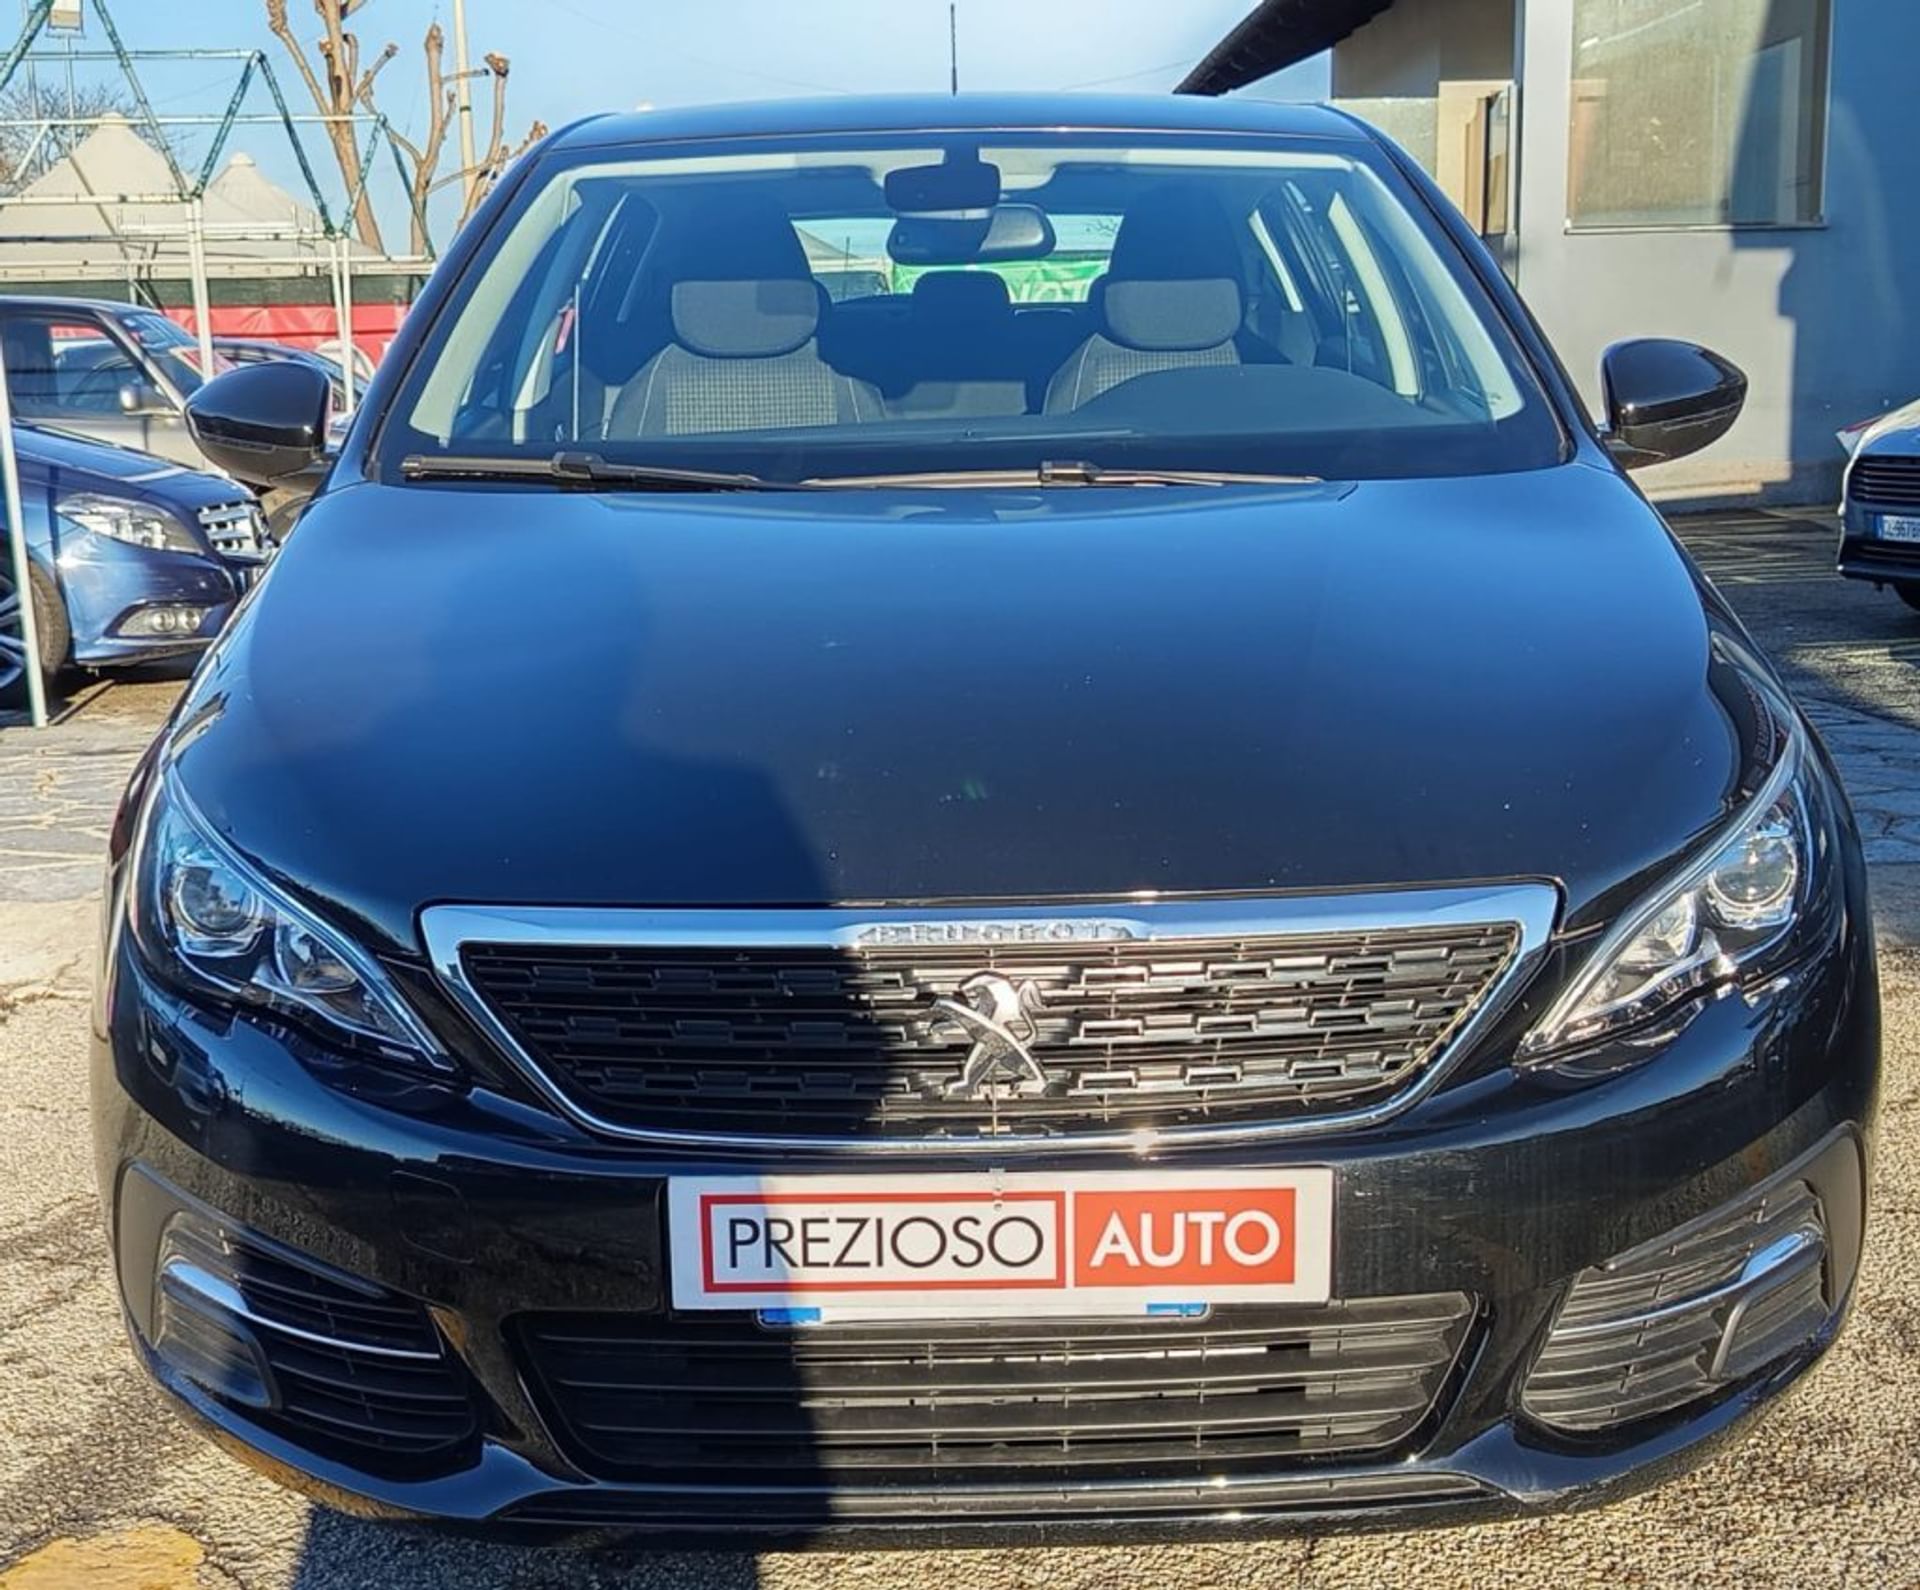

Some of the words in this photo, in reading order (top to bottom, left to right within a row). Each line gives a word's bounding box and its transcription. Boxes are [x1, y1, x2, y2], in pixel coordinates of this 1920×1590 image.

[873, 920, 1108, 943] PEUGEOT
[729, 1216, 1044, 1269] PREZIOSO
[1090, 1210, 1281, 1267] AUTO
